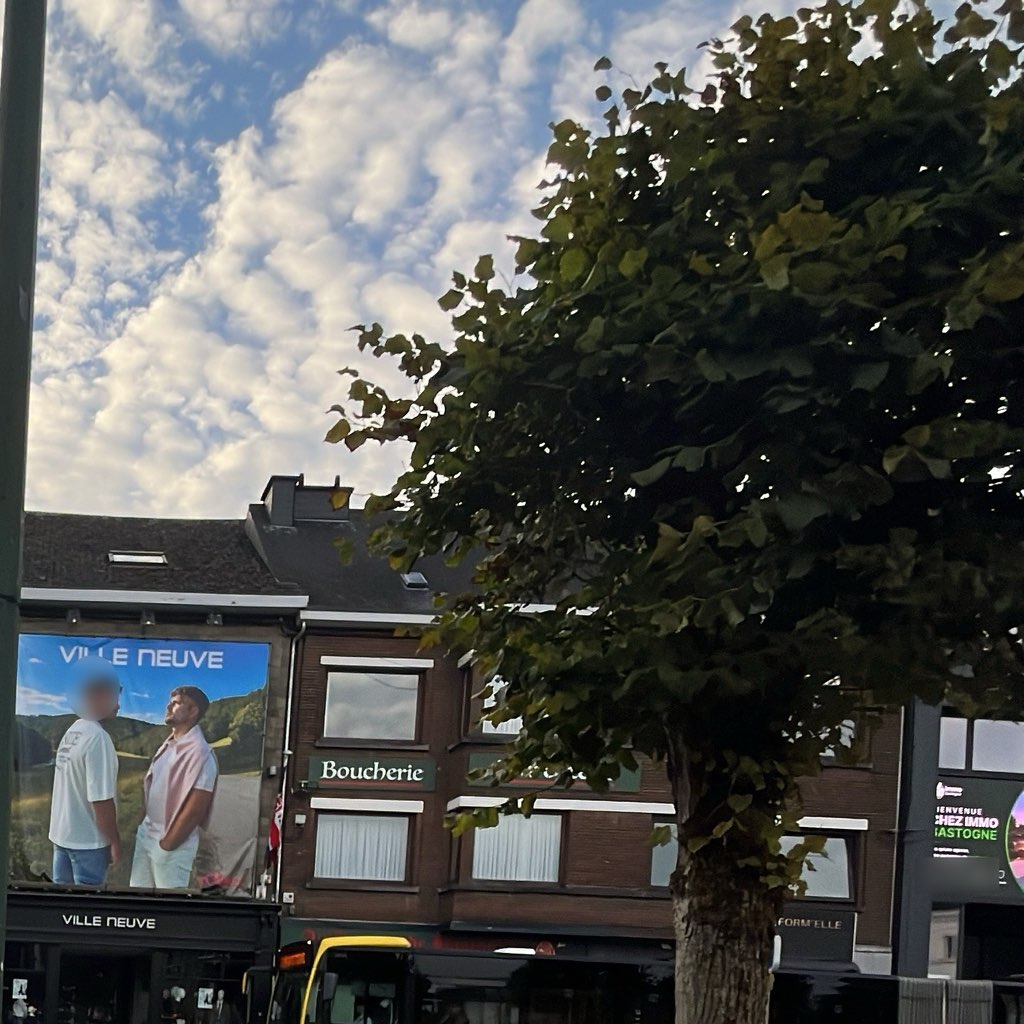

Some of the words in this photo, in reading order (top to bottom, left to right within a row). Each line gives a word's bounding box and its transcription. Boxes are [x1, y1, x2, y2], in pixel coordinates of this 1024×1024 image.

[138, 649, 224, 669] NEUVE
[320, 760, 424, 781] Boucherie
[936, 806, 983, 815] IENVENUE
[964, 816, 1000, 828] IMMO
[62, 914, 102, 927] VILLE
[106, 916, 156, 929] NEUVE
